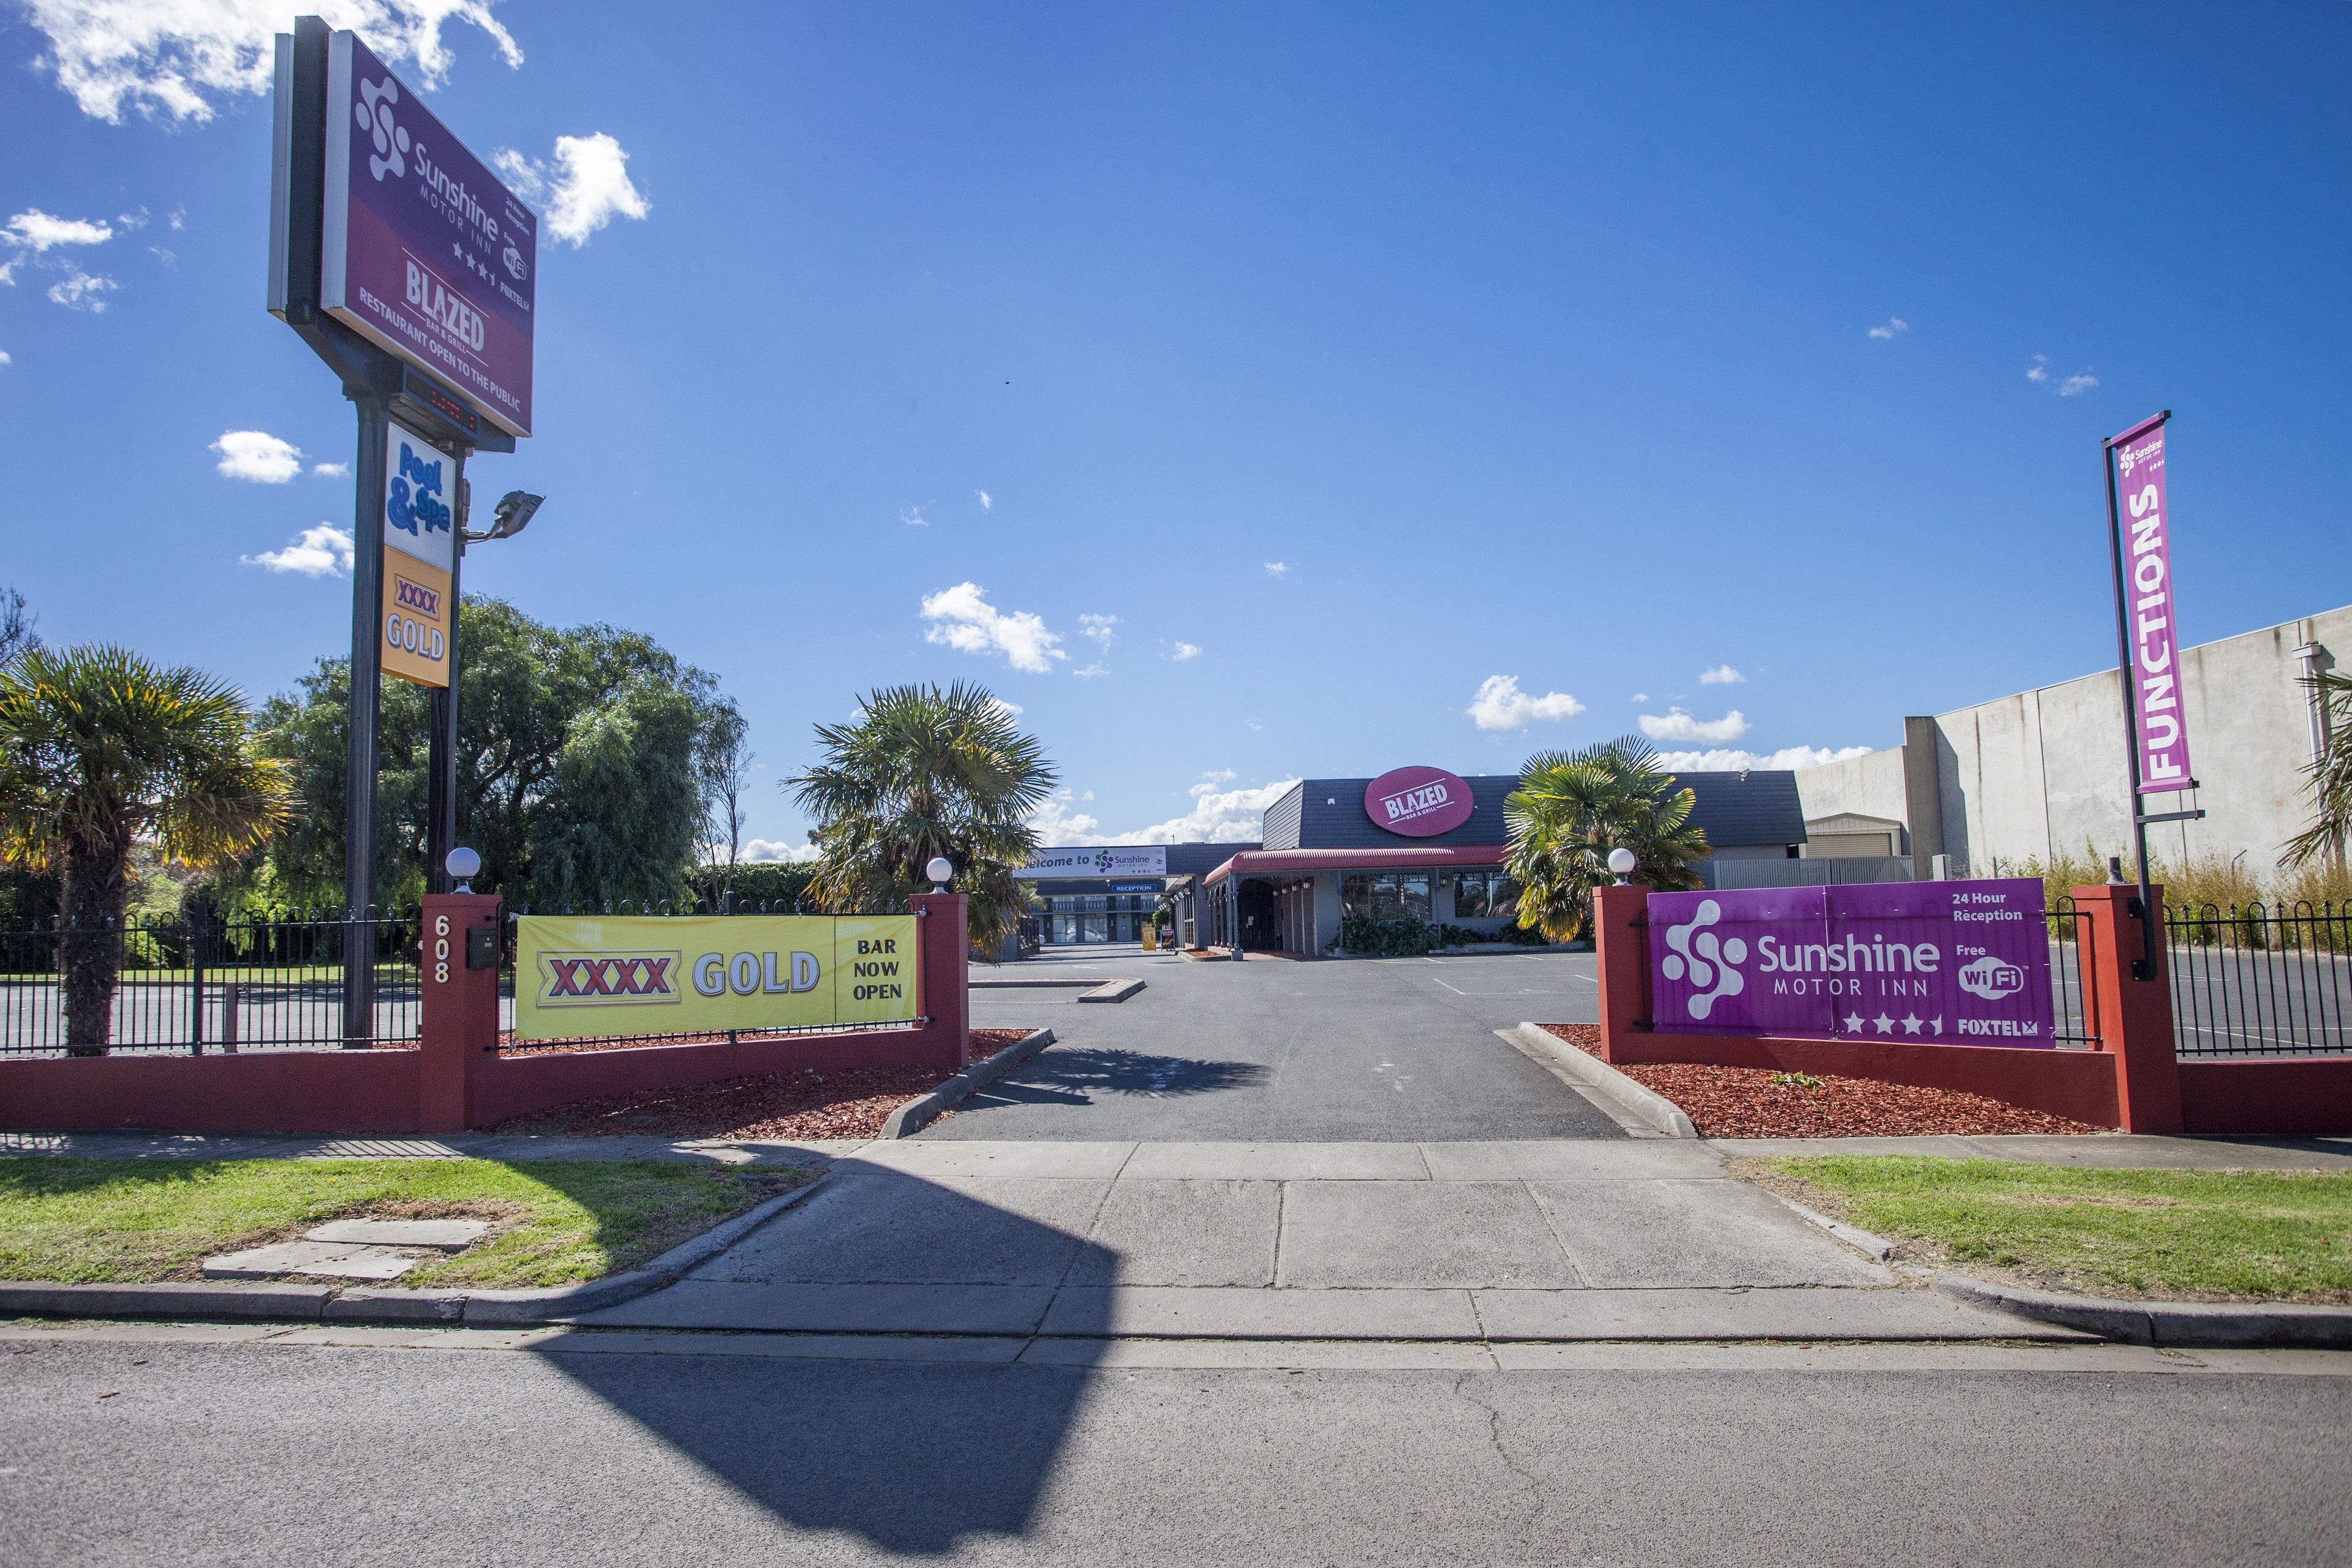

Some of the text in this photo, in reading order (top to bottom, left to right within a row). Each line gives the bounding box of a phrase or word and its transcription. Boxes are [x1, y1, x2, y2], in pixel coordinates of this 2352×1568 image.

[415, 143, 498, 241] Sunshine
[420, 184, 491, 255] MOTOR INN
[505, 208, 530, 236] Reception
[506, 197, 526, 220] 24 Hour
[503, 232, 516, 247] Free
[406, 260, 484, 352] BLAZED
[500, 281, 524, 308] FOXTEL
[360, 287, 428, 347] RESTAURANT
[429, 339, 456, 368] OPEN
[457, 358, 470, 377] TO
[470, 368, 489, 391] THE
[490, 381, 521, 412] PUBLIC
[426, 318, 467, 354] BAR & GRILL
[2135, 440, 2162, 460] Sunshine
[399, 441, 442, 496] Pool
[387, 477, 451, 537] & Spa
[398, 579, 438, 615] XXXX
[386, 613, 445, 661] GOLD
[2128, 484, 2182, 780] FUNCTIONS
[1385, 784, 1447, 819] BLAZED
[1019, 855, 1089, 869] elcome to
[1952, 893, 2006, 904] 24 Hour
[1953, 910, 2022, 923] Reception
[435, 915, 450, 983] 608
[858, 939, 896, 954] BAR
[1758, 933, 1940, 972] Sunshine
[1956, 945, 1986, 956] Free
[548, 951, 820, 998] XXXX GOLD
[854, 962, 899, 977] NOW
[853, 984, 902, 1000] OPEN
[1774, 979, 1927, 997] MOTOR INN
[1958, 1019, 2021, 1036] FOXTEL
